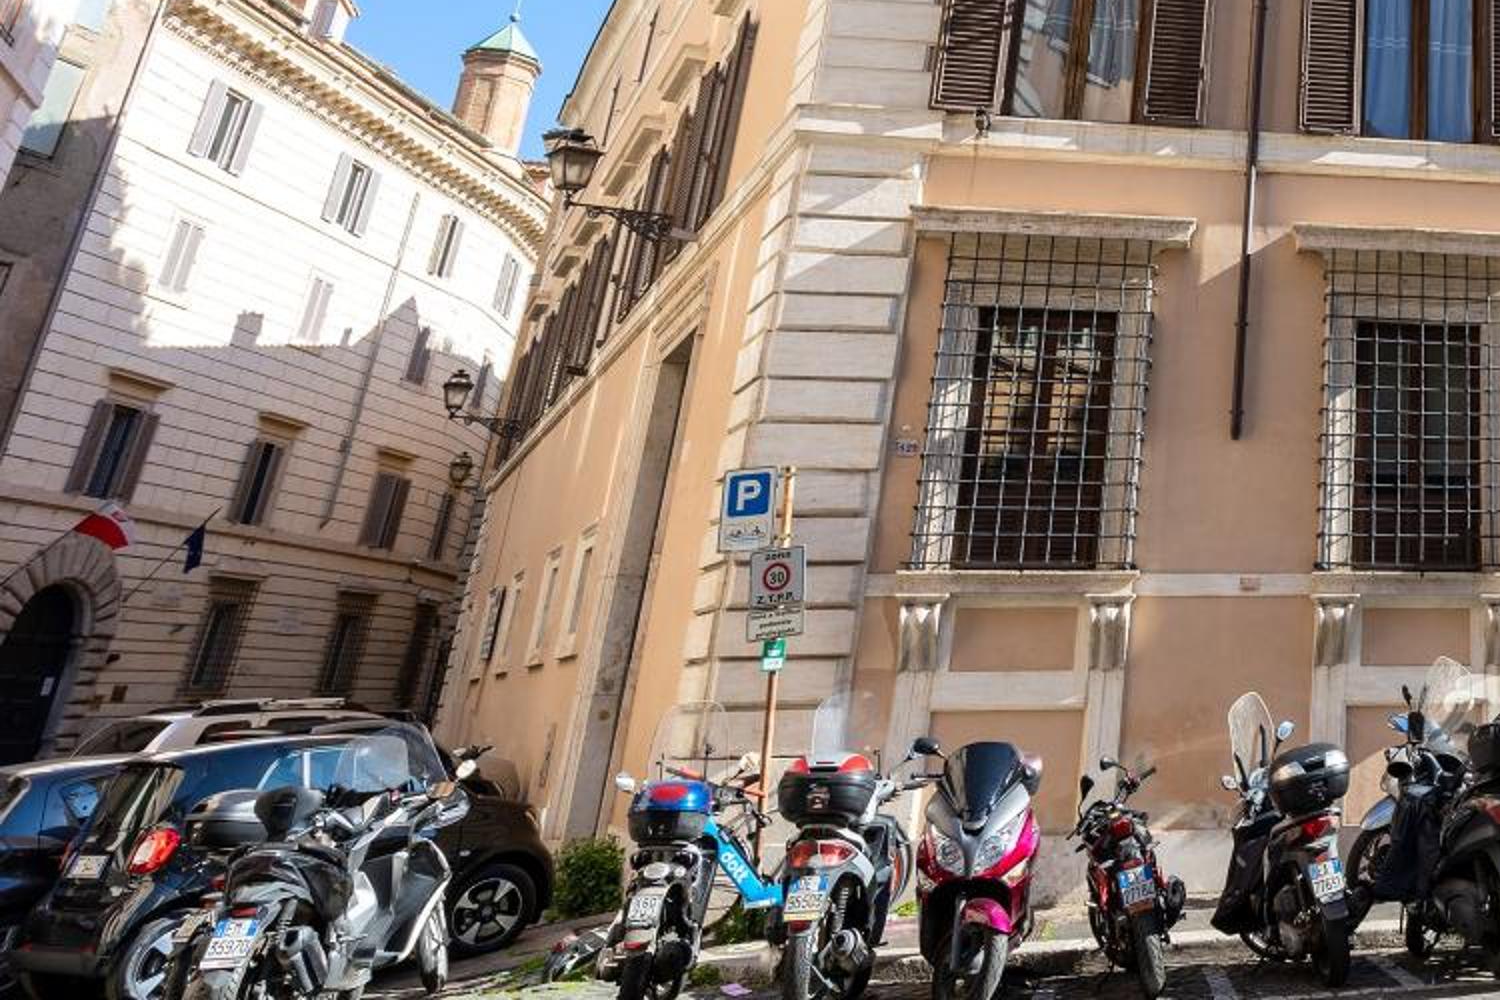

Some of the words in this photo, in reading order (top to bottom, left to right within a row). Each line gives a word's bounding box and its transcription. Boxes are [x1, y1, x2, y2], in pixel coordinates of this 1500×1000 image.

[736, 480, 761, 511] P
[769, 570, 786, 585] 30
[721, 851, 749, 885] dott
